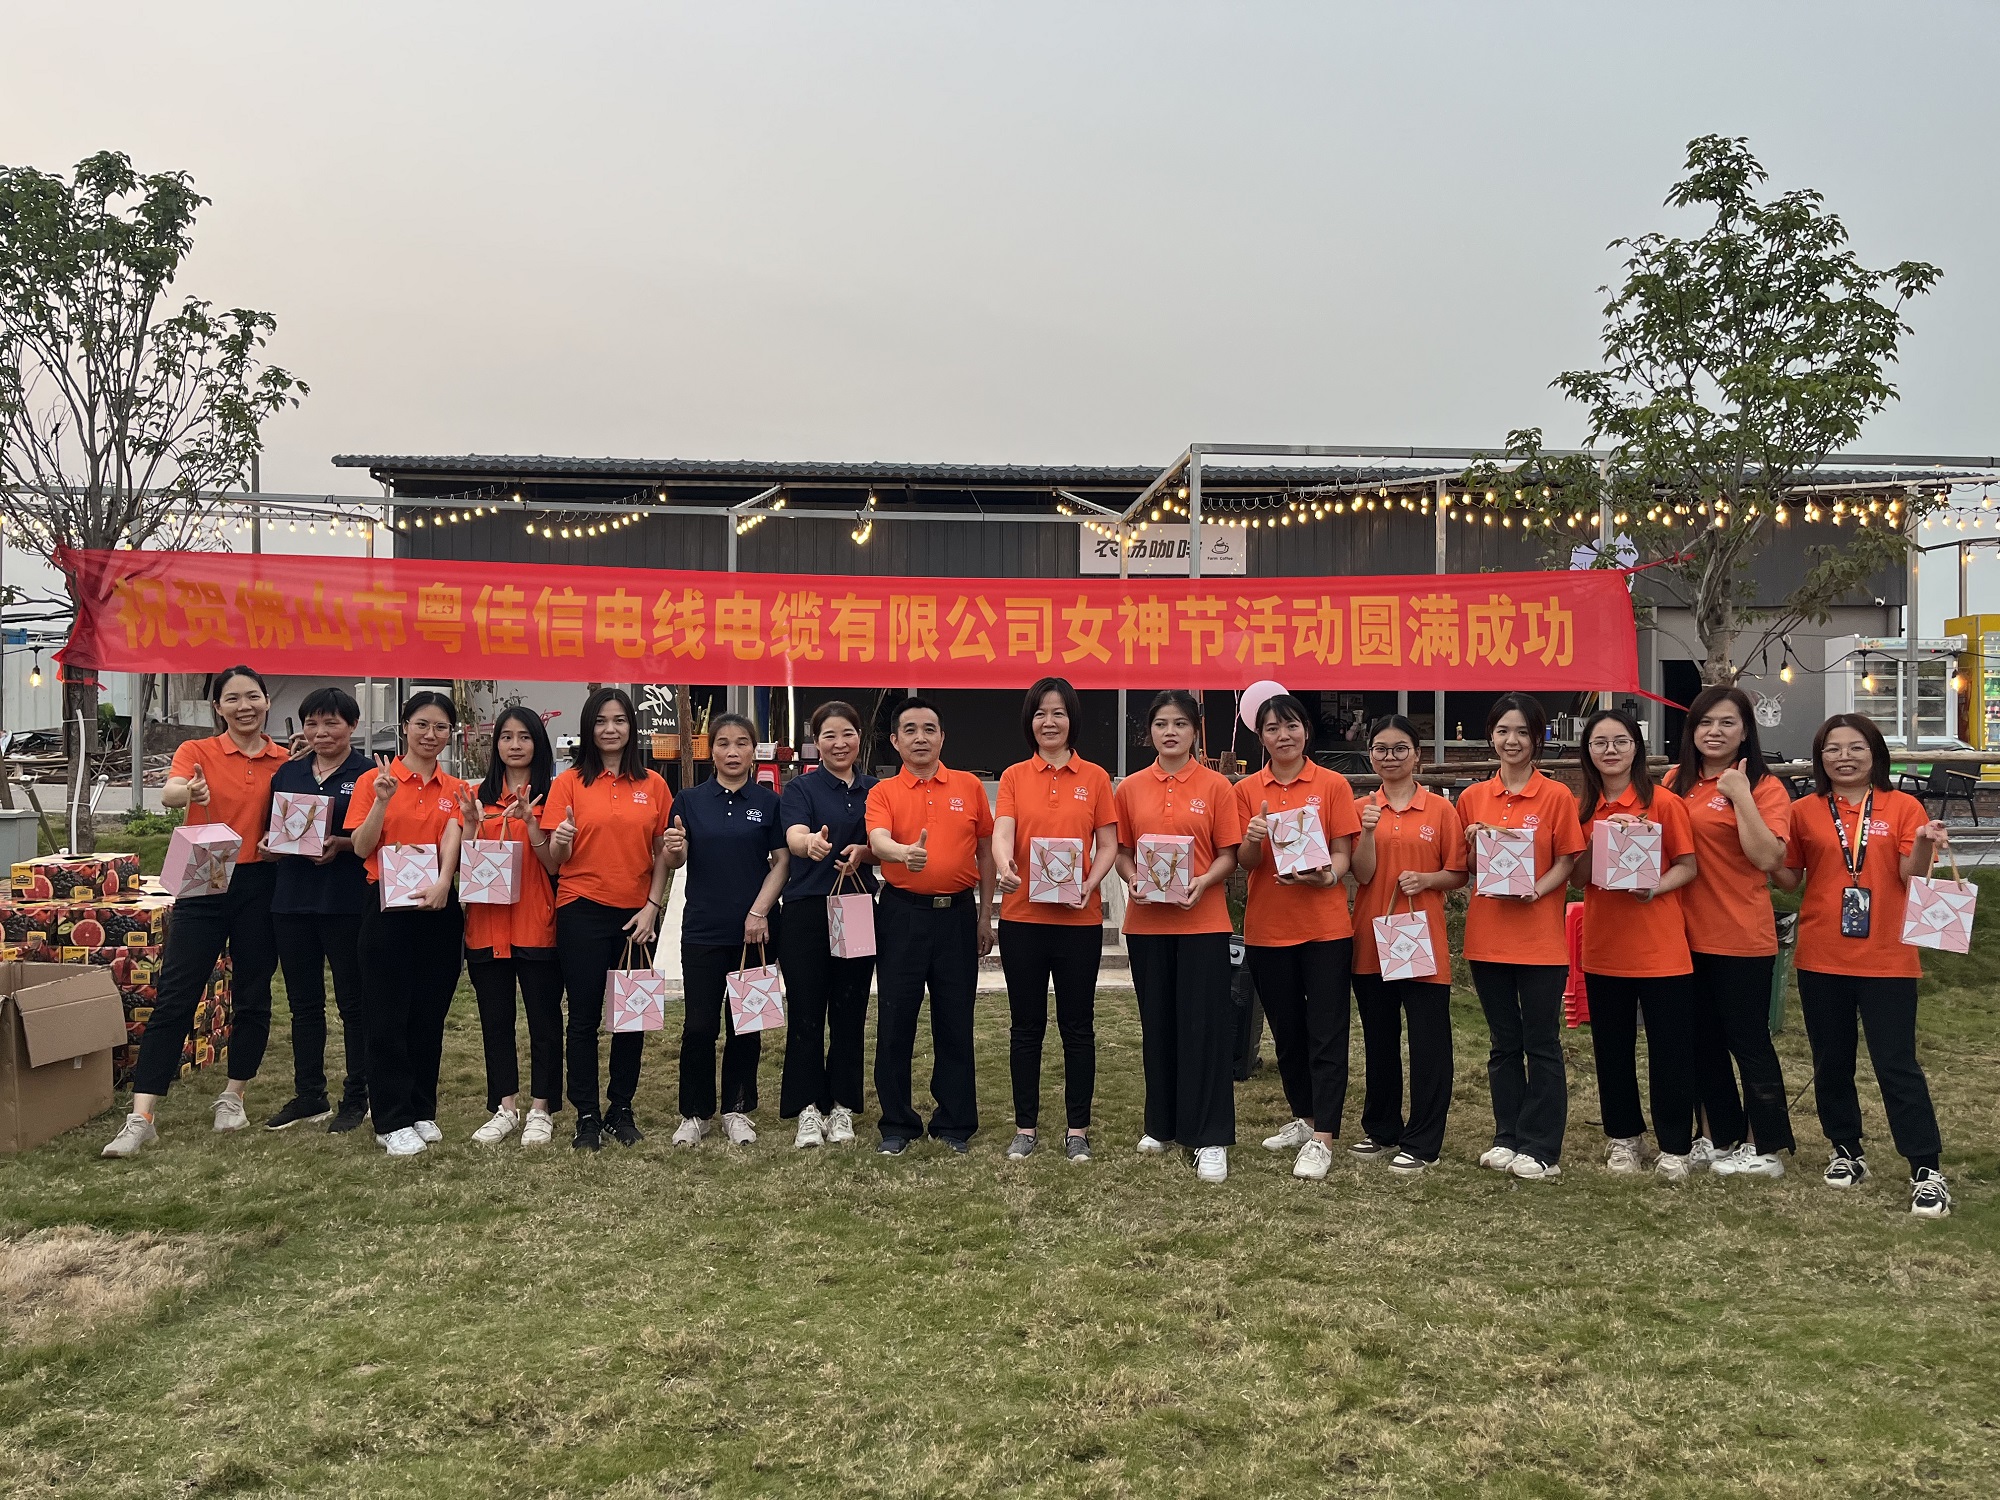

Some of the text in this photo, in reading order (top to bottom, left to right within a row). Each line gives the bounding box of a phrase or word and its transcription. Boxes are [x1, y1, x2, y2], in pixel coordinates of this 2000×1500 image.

[112, 577, 1574, 667] 祝贺佛山市粤佳信电线电缆有限公司女神节活动圆满成功
